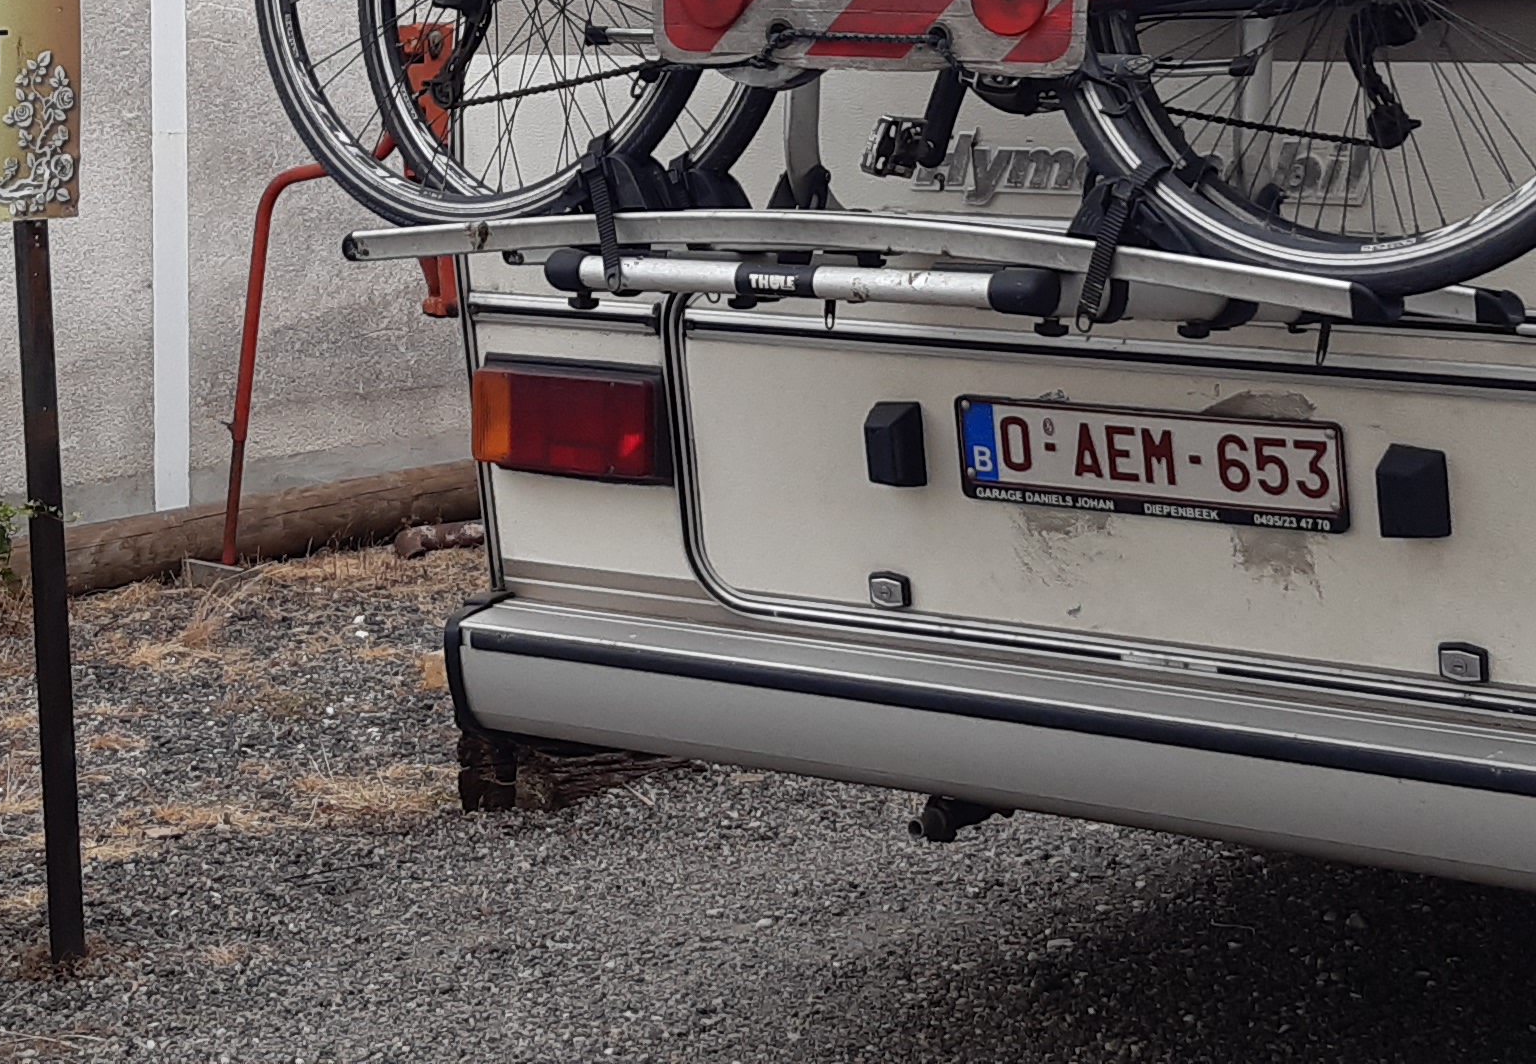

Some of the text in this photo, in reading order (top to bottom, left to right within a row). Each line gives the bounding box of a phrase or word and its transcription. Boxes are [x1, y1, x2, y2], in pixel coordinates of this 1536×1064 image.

[748, 273, 796, 291] THULE
[972, 445, 994, 473] B
[975, 486, 1331, 531] GARAGE DANIELS JOHAN DIEPENBEEK 0495/23 47 70
